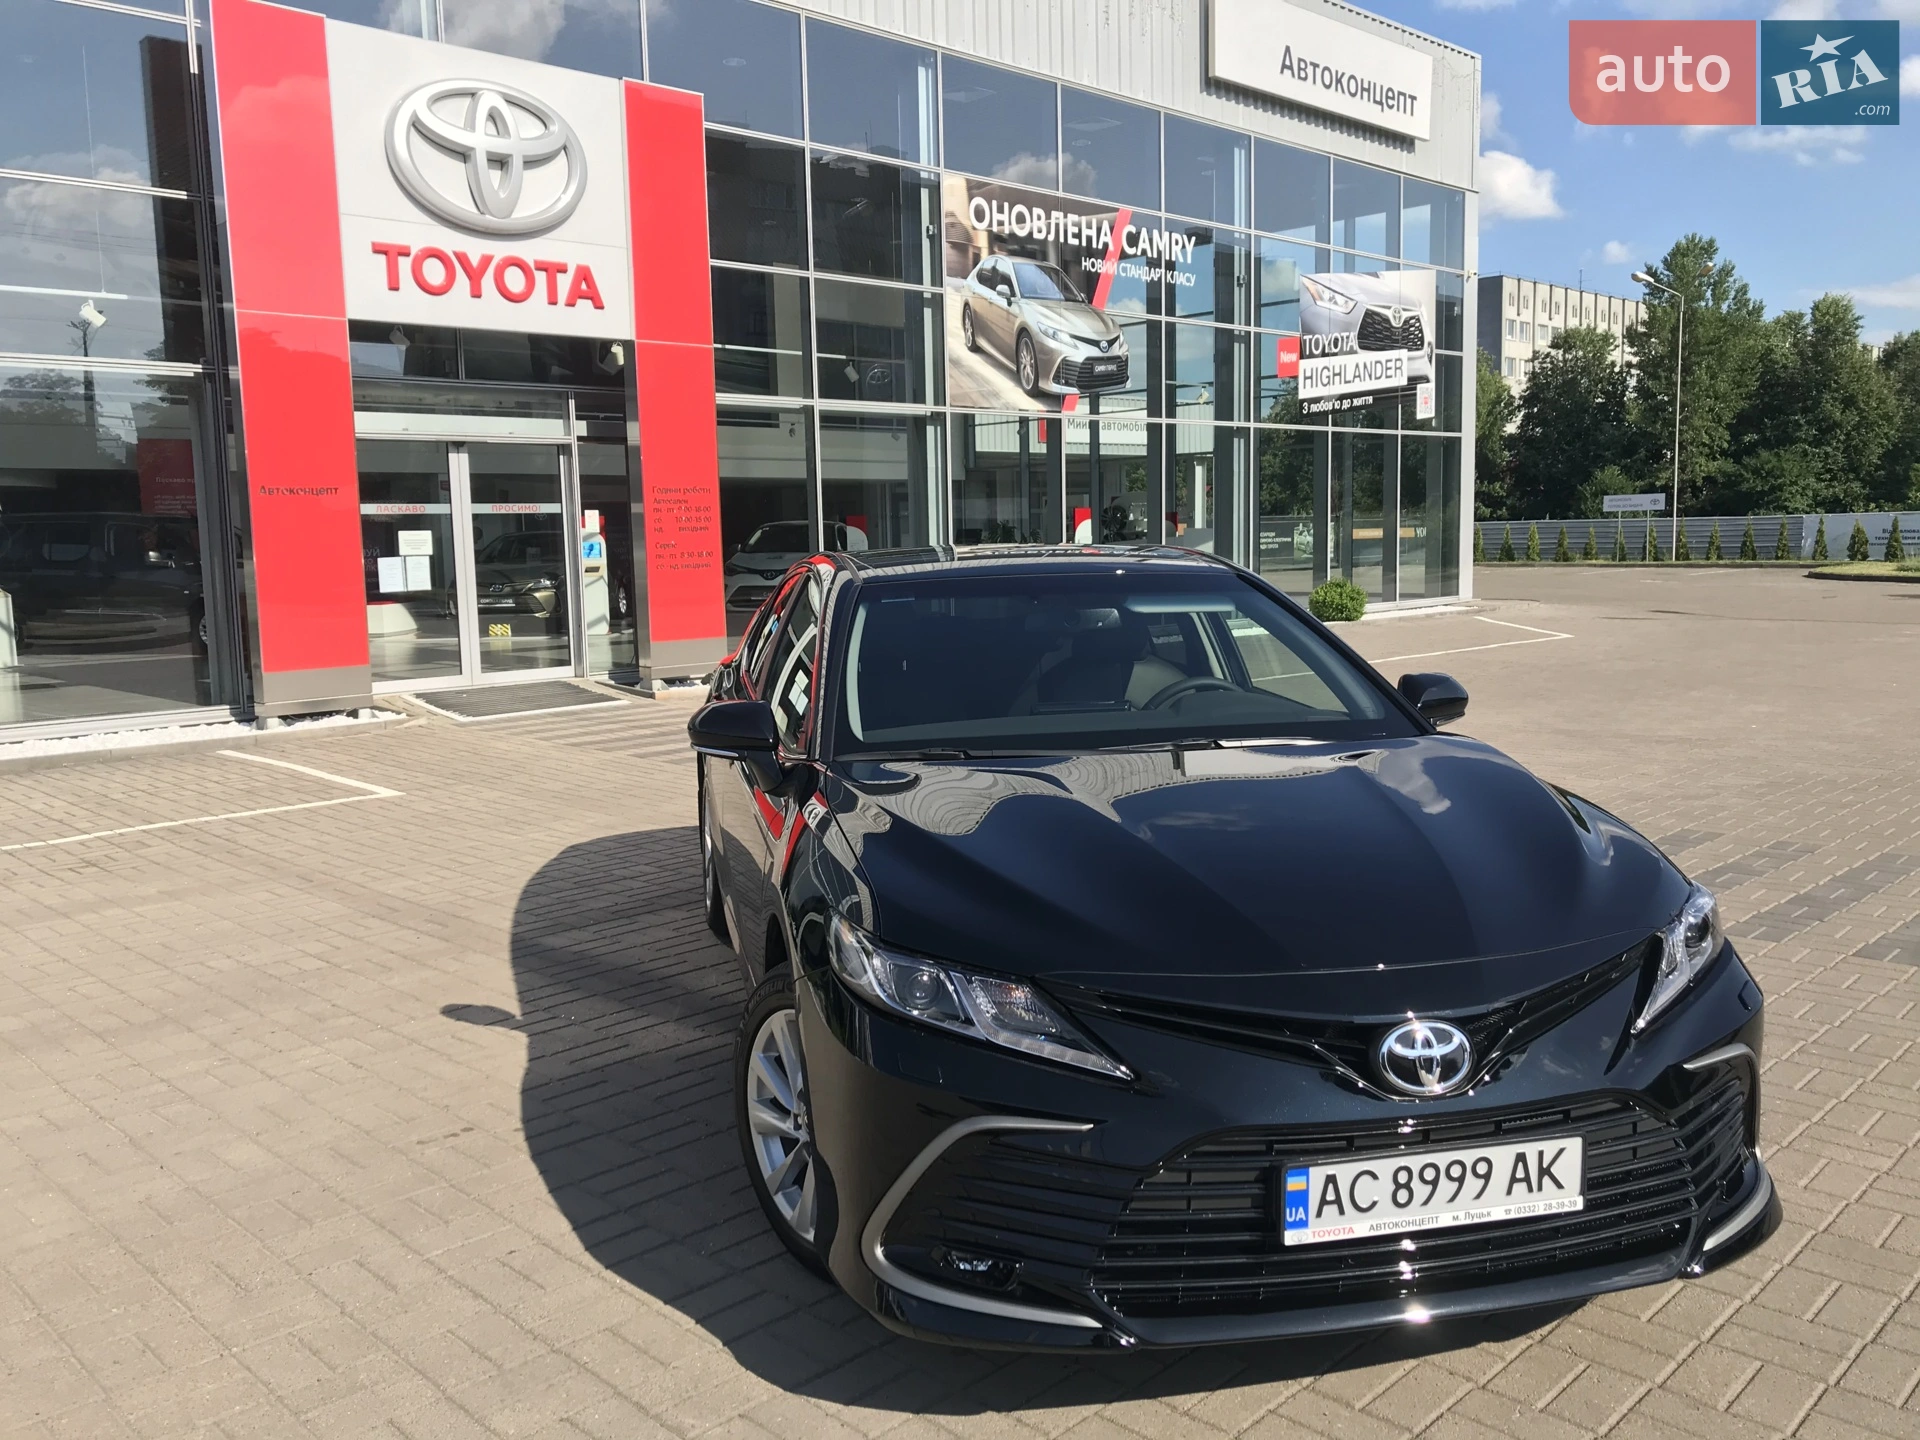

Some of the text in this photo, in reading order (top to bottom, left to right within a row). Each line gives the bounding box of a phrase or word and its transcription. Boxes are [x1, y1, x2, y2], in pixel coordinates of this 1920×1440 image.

[1280, 45, 1418, 117] Автоконцепт
[969, 196, 1197, 264] ОНОВЛЕНА CAMRY
[371, 241, 605, 310] TOYOTA
[1082, 256, 1197, 287] НОВИЙ СТАНДАРТ КЛАСУ
[1303, 331, 1357, 356] TOYOTA
[1280, 351, 1298, 363] New
[1303, 358, 1404, 389] HIGHLANDER
[1302, 395, 1373, 414] З любов'ю до життя
[1101, 421, 1147, 431] автомобіл
[259, 485, 339, 497] Автоконцепт
[652, 485, 711, 495] Години роботи
[376, 505, 541, 513] ЛАСКАВО ПРОСИМО!
[1315, 1146, 1567, 1219] AC 8999 AK
[1286, 1206, 1307, 1222] UA
[1311, 1200, 1578, 1239] TOYOTA АВТОКОНЦЕПТ м. Луцьк (0332) 28-39-39
